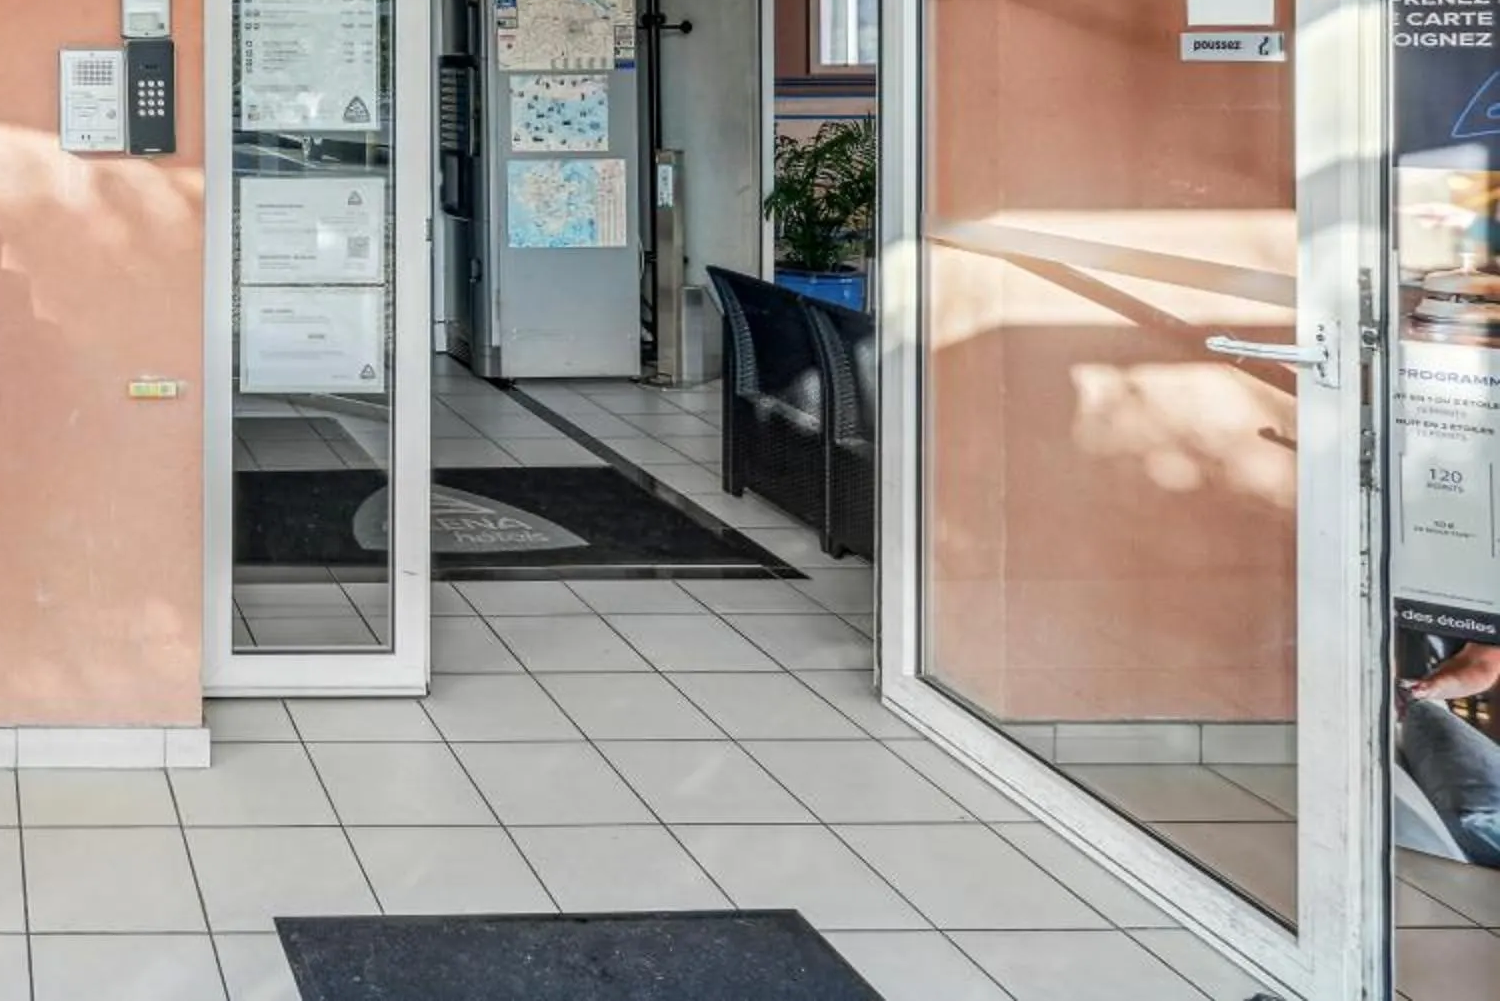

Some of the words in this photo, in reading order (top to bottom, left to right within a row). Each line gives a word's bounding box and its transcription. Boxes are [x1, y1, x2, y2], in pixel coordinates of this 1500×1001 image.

[1406, 12, 1493, 27] CARTE
[1193, 40, 1243, 52] poussez
[1394, 32, 1493, 47] OIGNEZ
[1428, 467, 1463, 484] 120
[1401, 608, 1435, 624] des
[1436, 613, 1497, 635] étoiles
